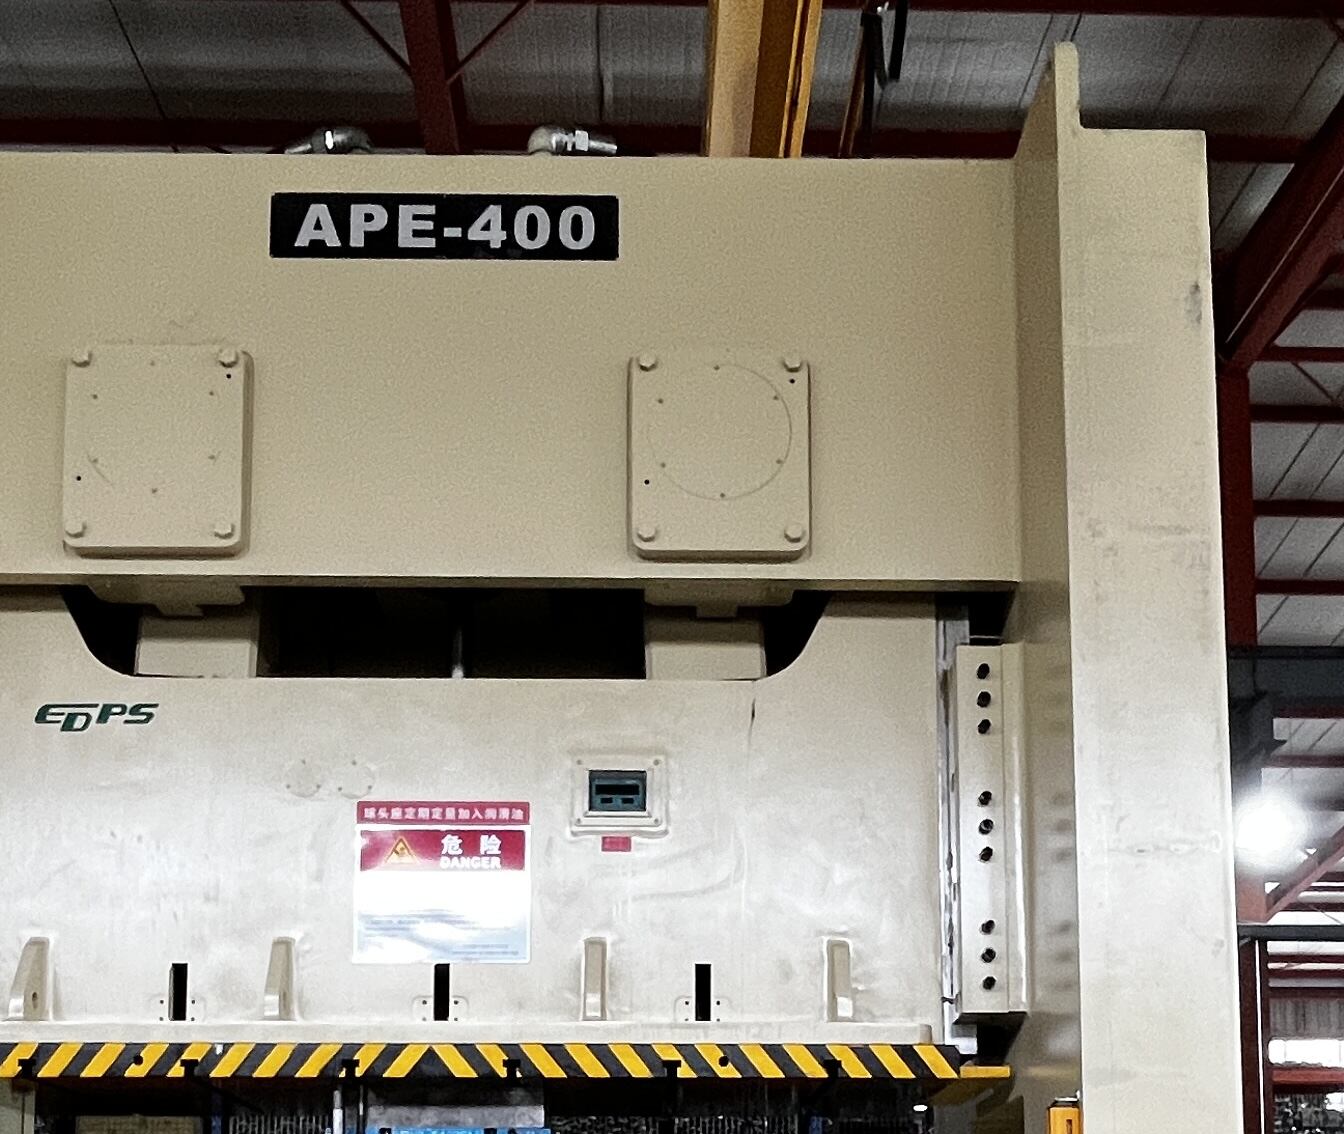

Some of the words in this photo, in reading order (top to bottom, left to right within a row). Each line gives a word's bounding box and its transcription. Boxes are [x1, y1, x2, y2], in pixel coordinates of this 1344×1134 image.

[294, 203, 596, 250] APE-400
[34, 703, 160, 732] EDPS
[440, 834, 502, 855] 危险
[439, 856, 502, 869] DANGER
